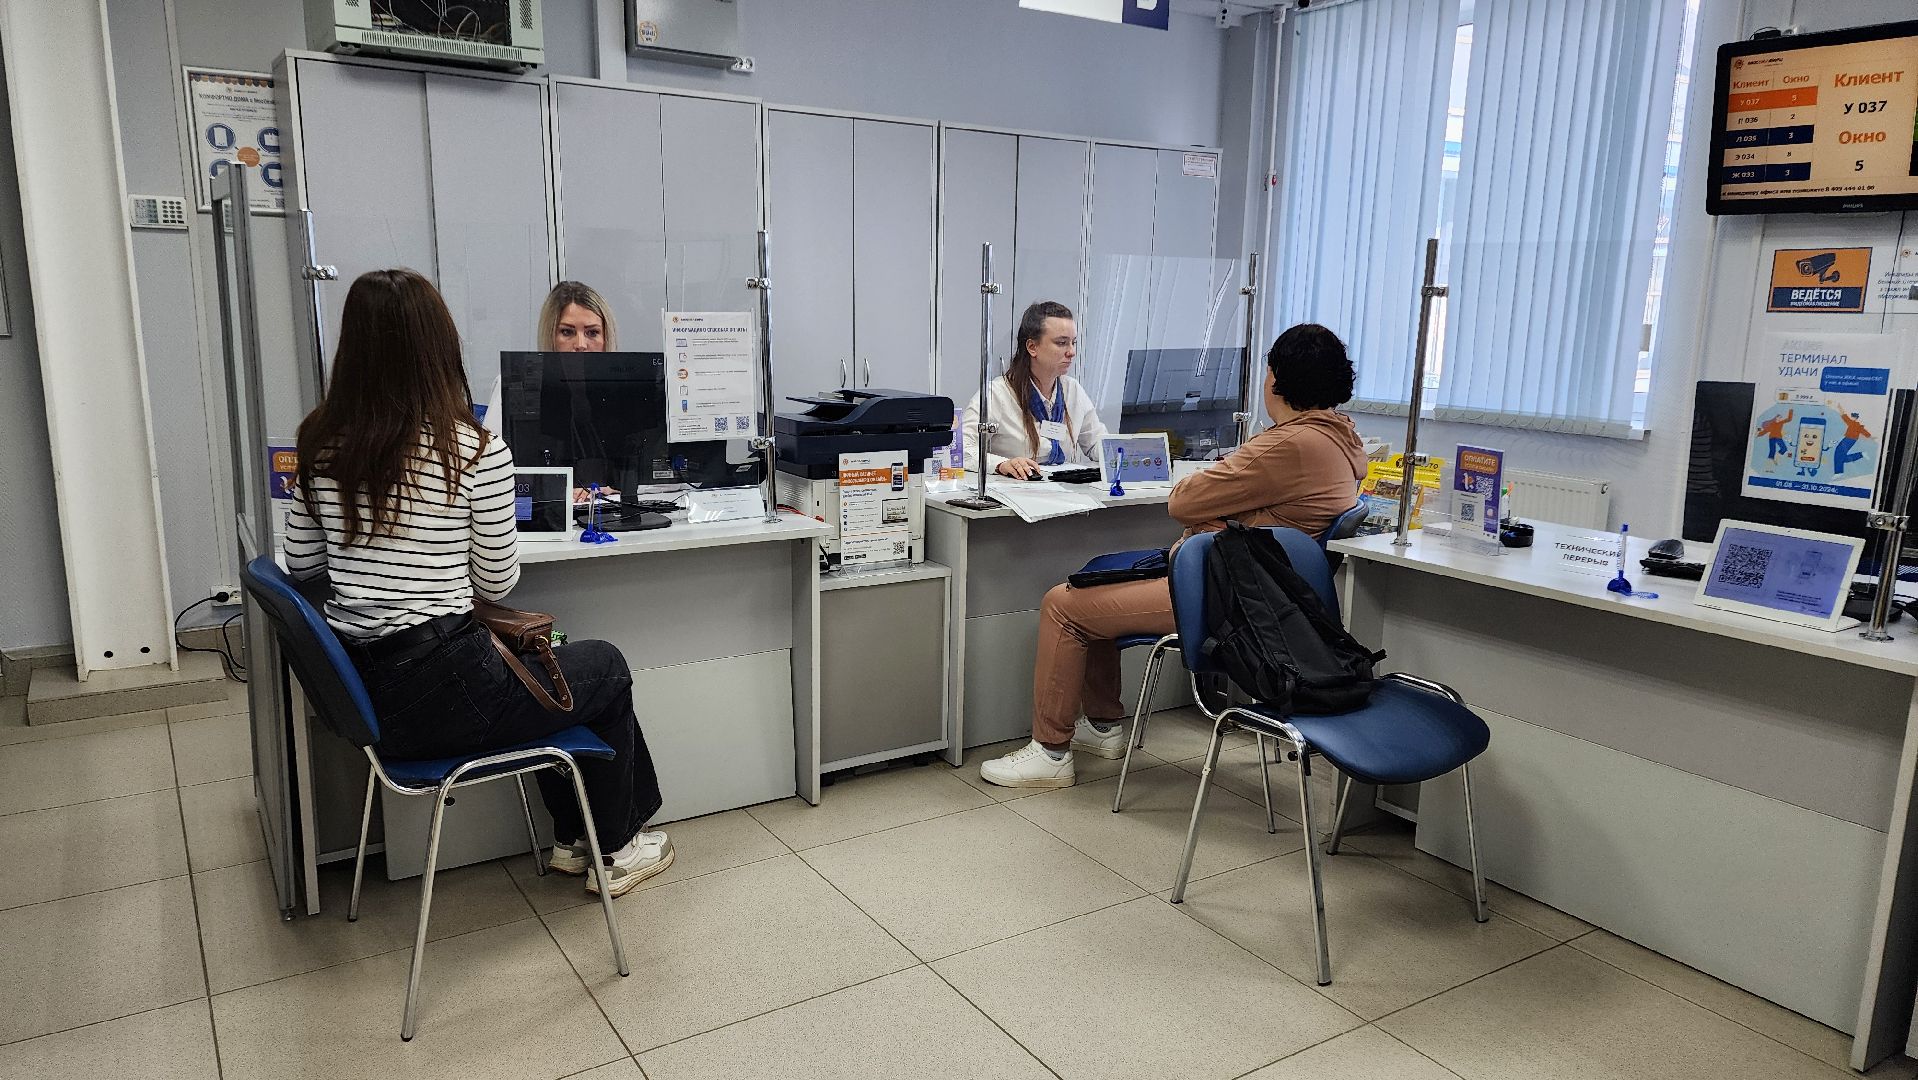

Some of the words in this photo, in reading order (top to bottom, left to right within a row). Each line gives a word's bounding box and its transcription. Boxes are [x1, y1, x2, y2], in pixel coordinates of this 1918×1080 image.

[1733, 80, 1770, 89] Клиент
[1783, 75, 1810, 84] Окно
[1833, 71, 1905, 88] Клиент
[1746, 98, 1760, 106] 037
[1844, 102, 1855, 115] У
[1858, 99, 1888, 114] 037
[1745, 116, 1759, 124] 036
[1838, 130, 1887, 145] Окно
[1854, 159, 1865, 172] 5
[1784, 169, 1790, 177] 3
[1791, 288, 1842, 302] ВЕДЁТСЯ
[1779, 353, 1848, 365] ТЕРМИНАЛ
[1778, 366, 1819, 378] УДАЧИ
[1562, 553, 1609, 566] ПЕРЕРЫВ
